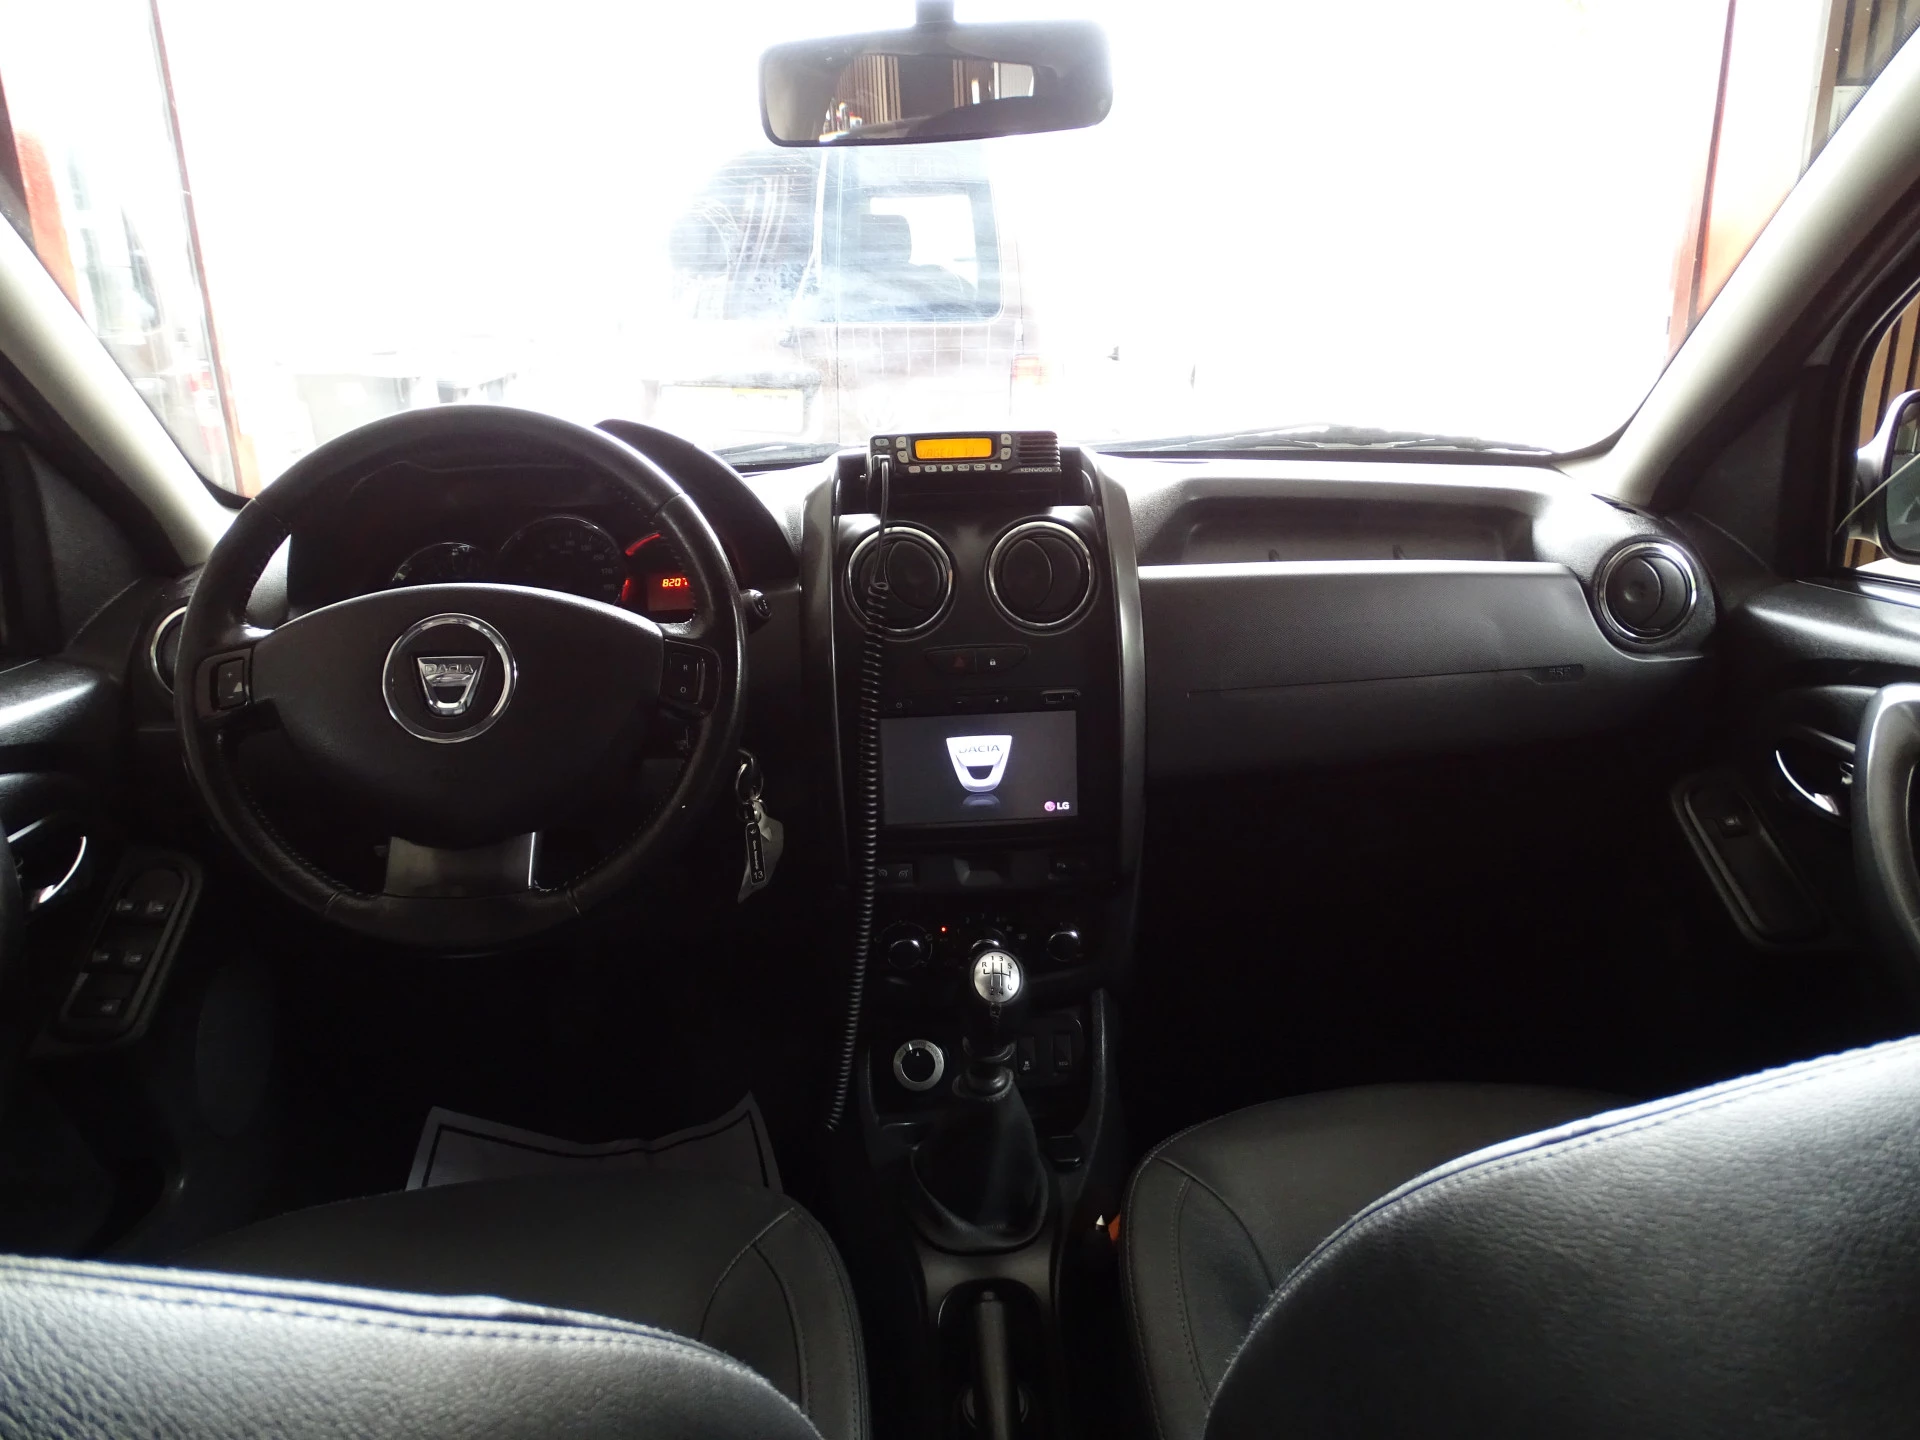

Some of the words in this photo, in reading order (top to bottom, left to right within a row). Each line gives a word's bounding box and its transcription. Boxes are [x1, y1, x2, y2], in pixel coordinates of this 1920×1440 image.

[424, 663, 474, 675] DACIA
[958, 744, 1000, 754] DACIA
[1056, 801, 1070, 810] LG
[753, 870, 764, 880] 13
